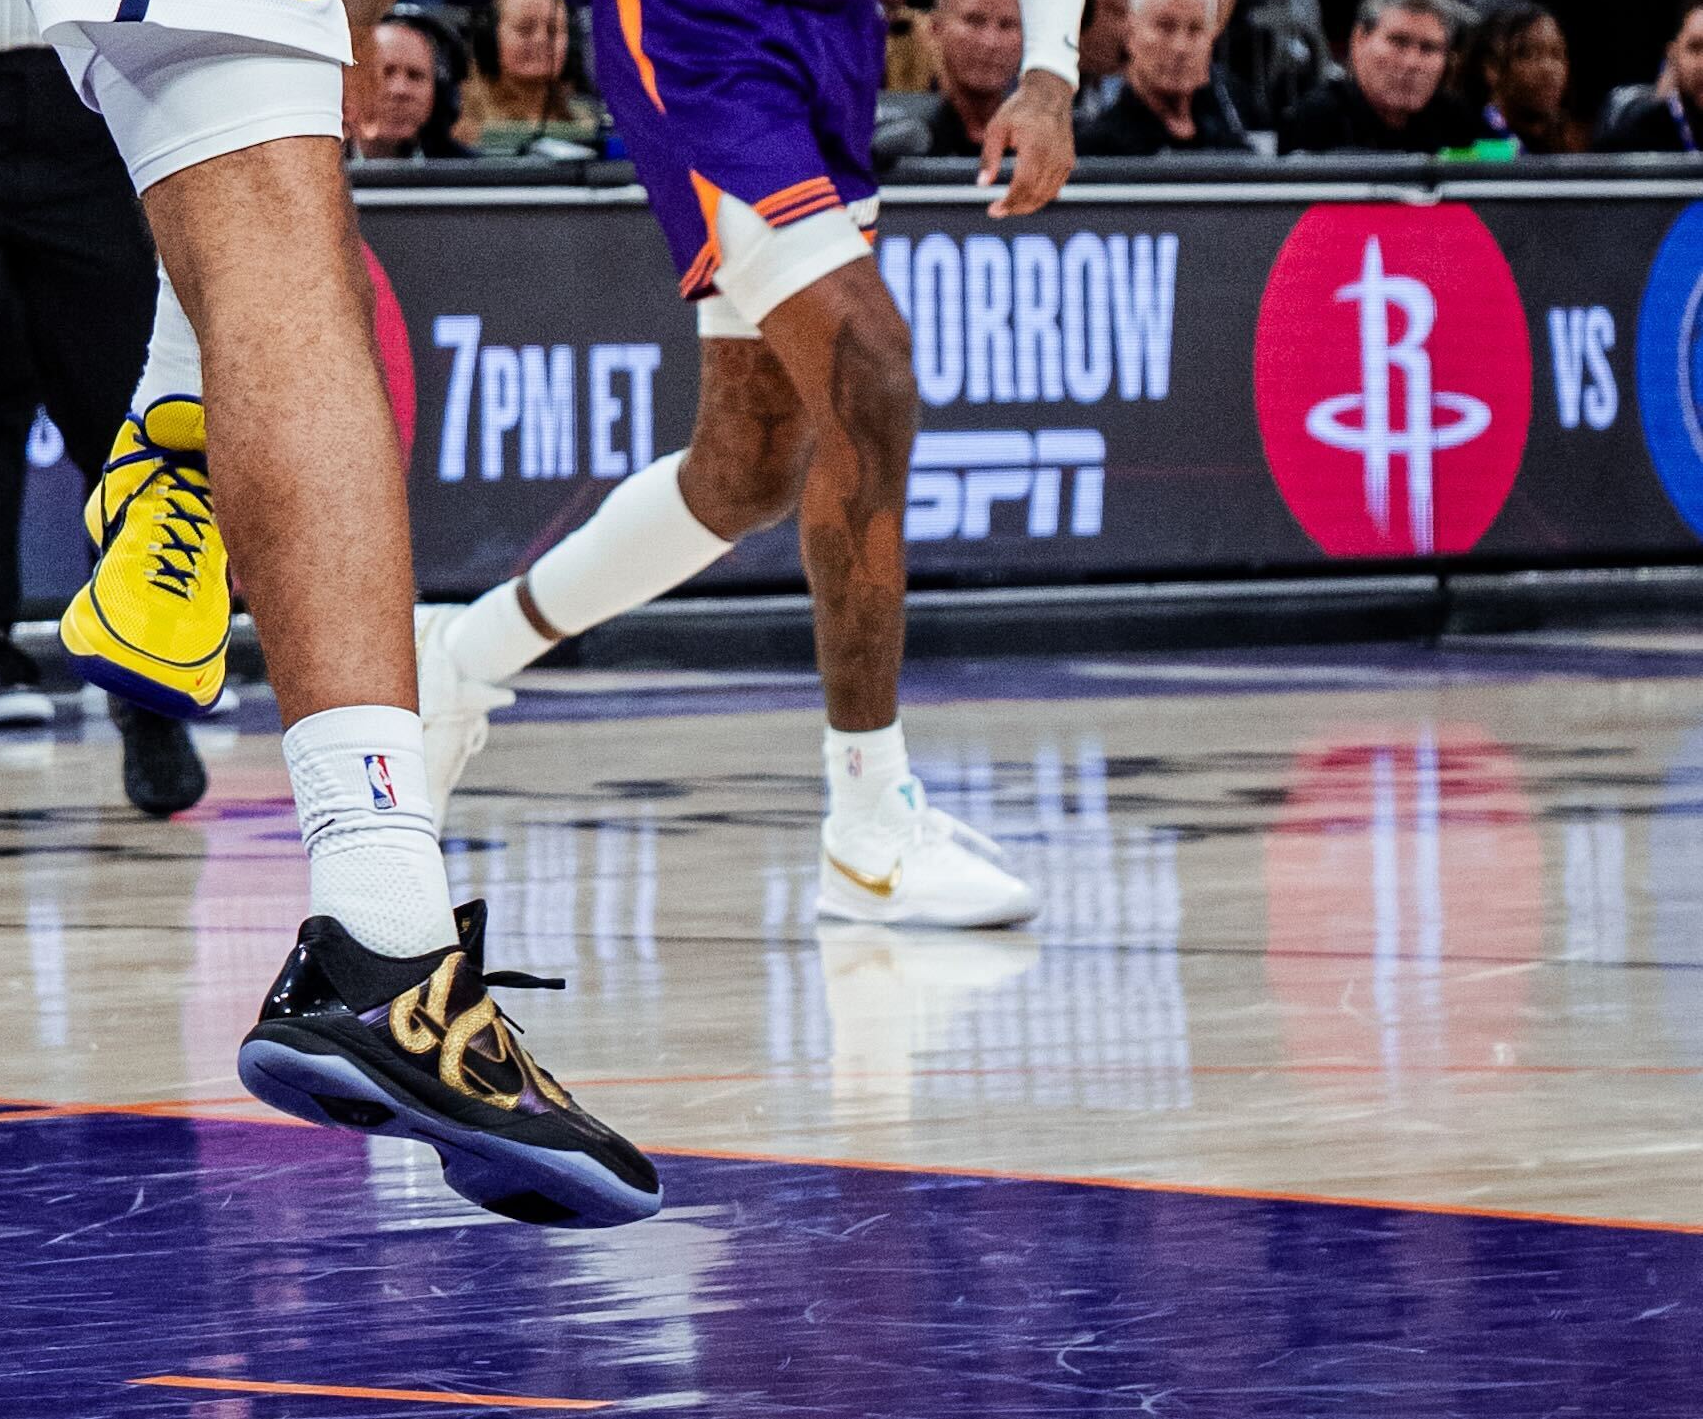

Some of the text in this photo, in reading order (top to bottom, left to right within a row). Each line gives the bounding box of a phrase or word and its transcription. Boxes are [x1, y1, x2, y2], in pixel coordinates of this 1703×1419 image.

[879, 229, 1180, 407] ORROW
[1547, 305, 1619, 431] VS
[589, 342, 663, 480] ET
[903, 428, 1107, 543] SPN
